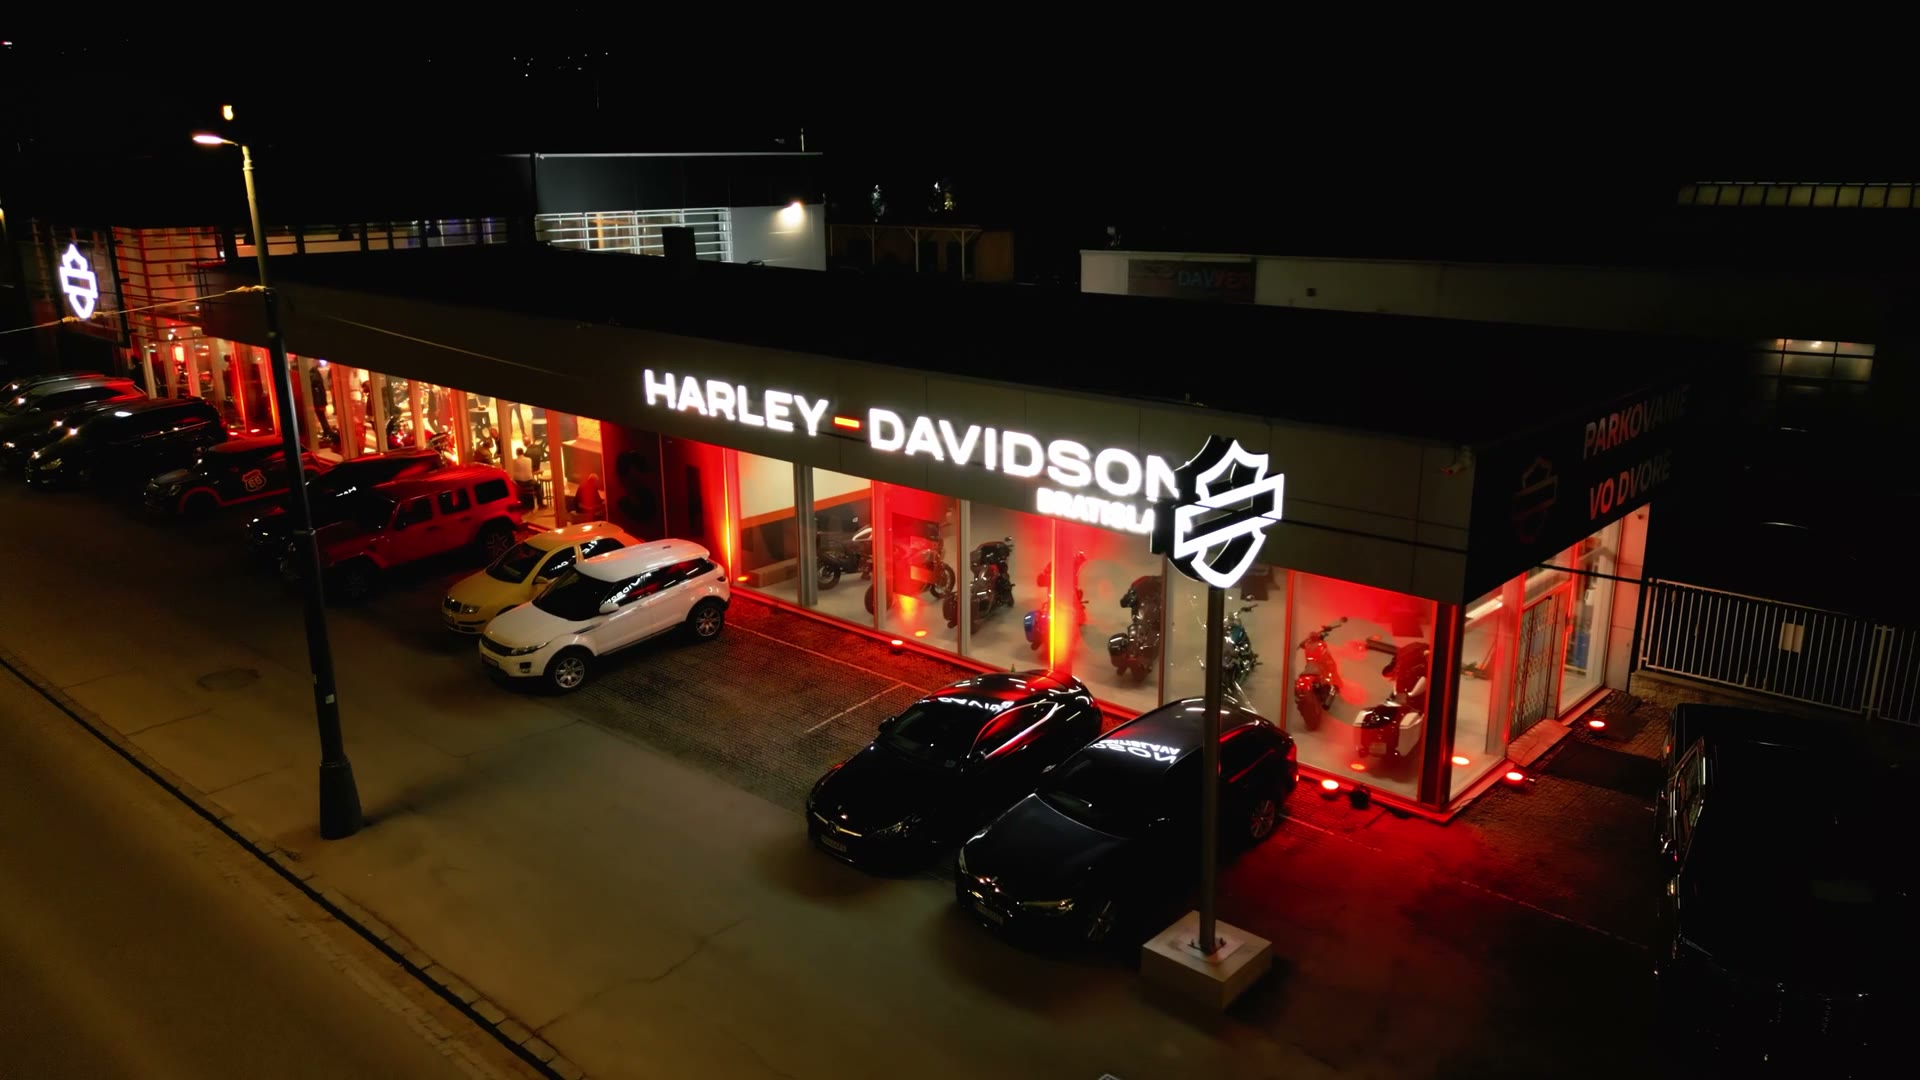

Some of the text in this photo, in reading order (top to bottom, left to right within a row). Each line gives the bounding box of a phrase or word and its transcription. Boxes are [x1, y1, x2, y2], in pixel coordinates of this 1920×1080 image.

[1036, 487, 1155, 534] BRATISLA
[1590, 449, 1672, 521] VO DVORE
